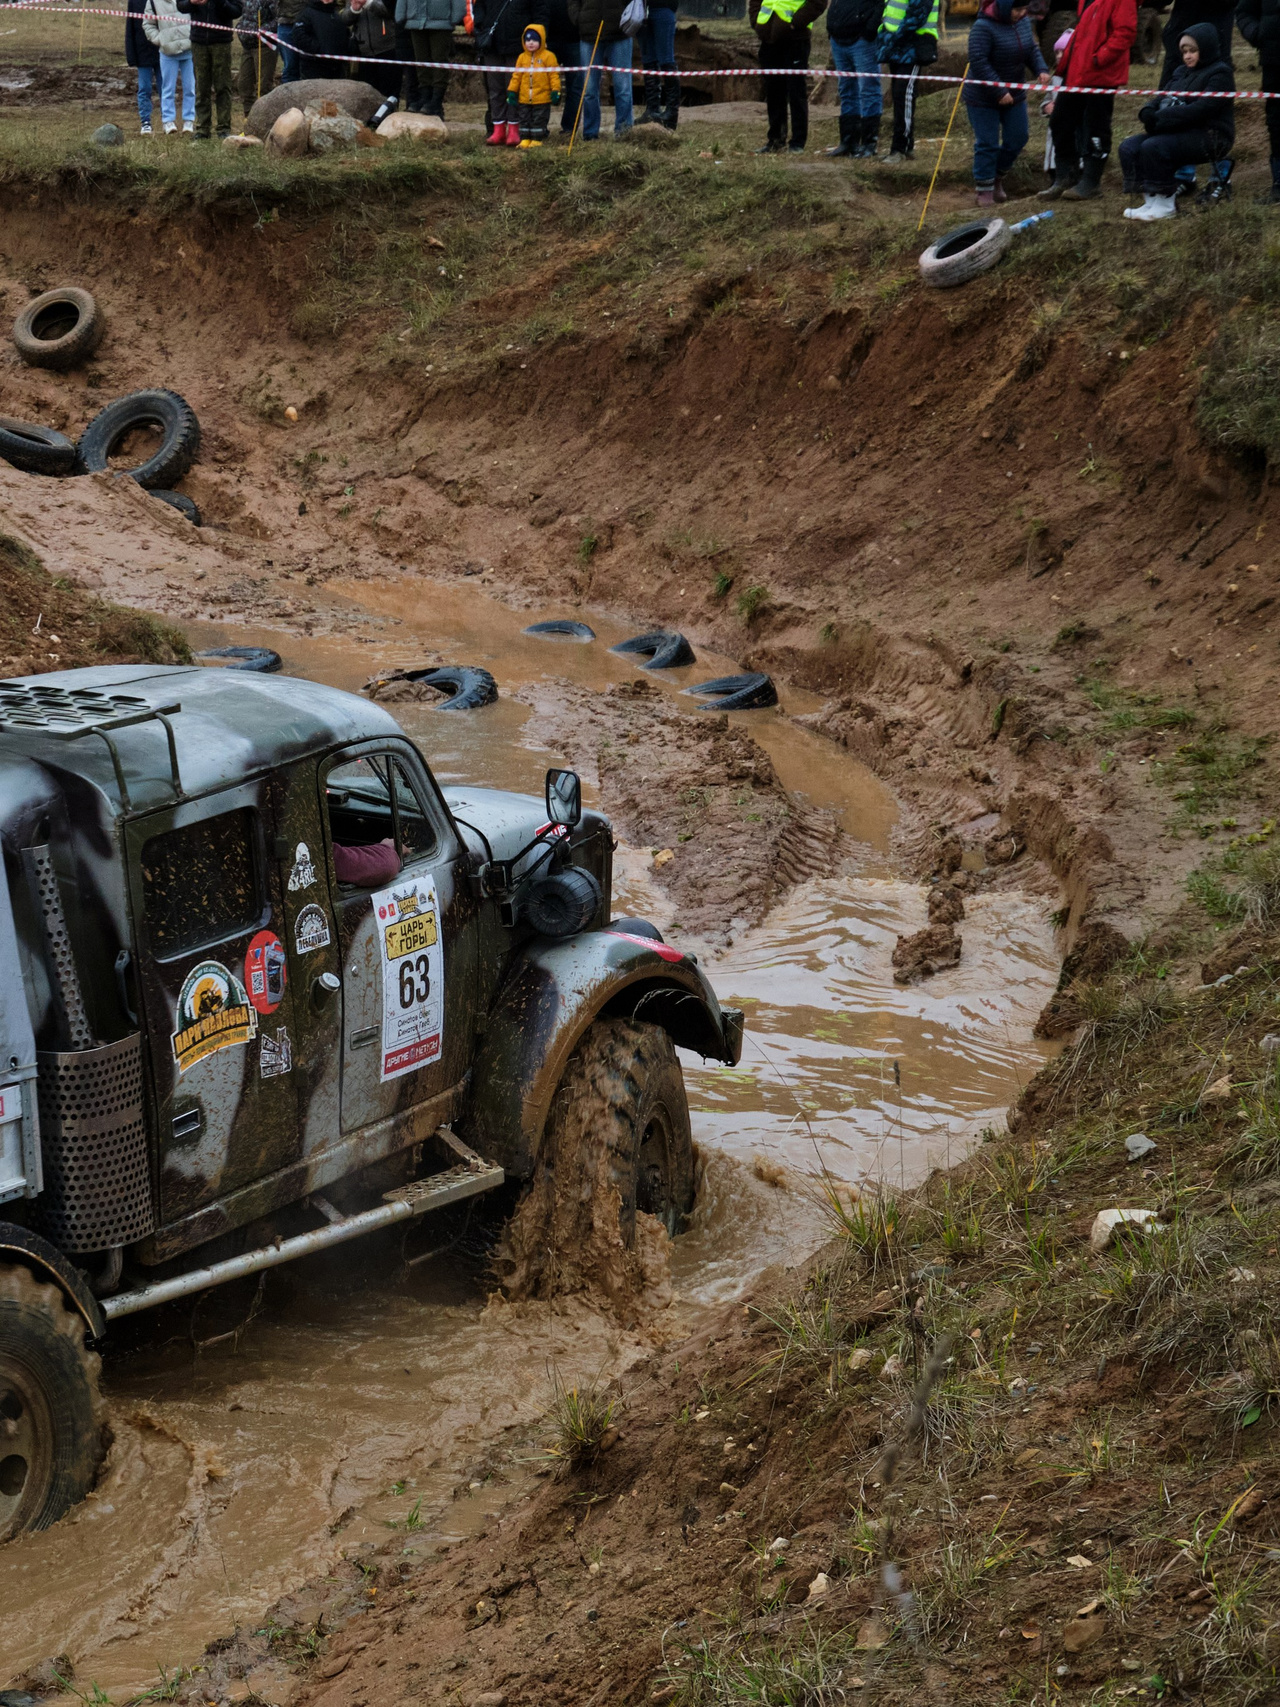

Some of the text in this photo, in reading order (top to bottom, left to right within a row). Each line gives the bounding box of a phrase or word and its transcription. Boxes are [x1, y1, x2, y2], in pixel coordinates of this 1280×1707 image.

[400, 919, 424, 937] ЦАРЬ
[399, 931, 428, 953] ГОРЫ
[399, 953, 431, 1010] 63
[174, 1021, 203, 1054] ПАРК
[386, 1051, 410, 1069] ДРУГИЕ
